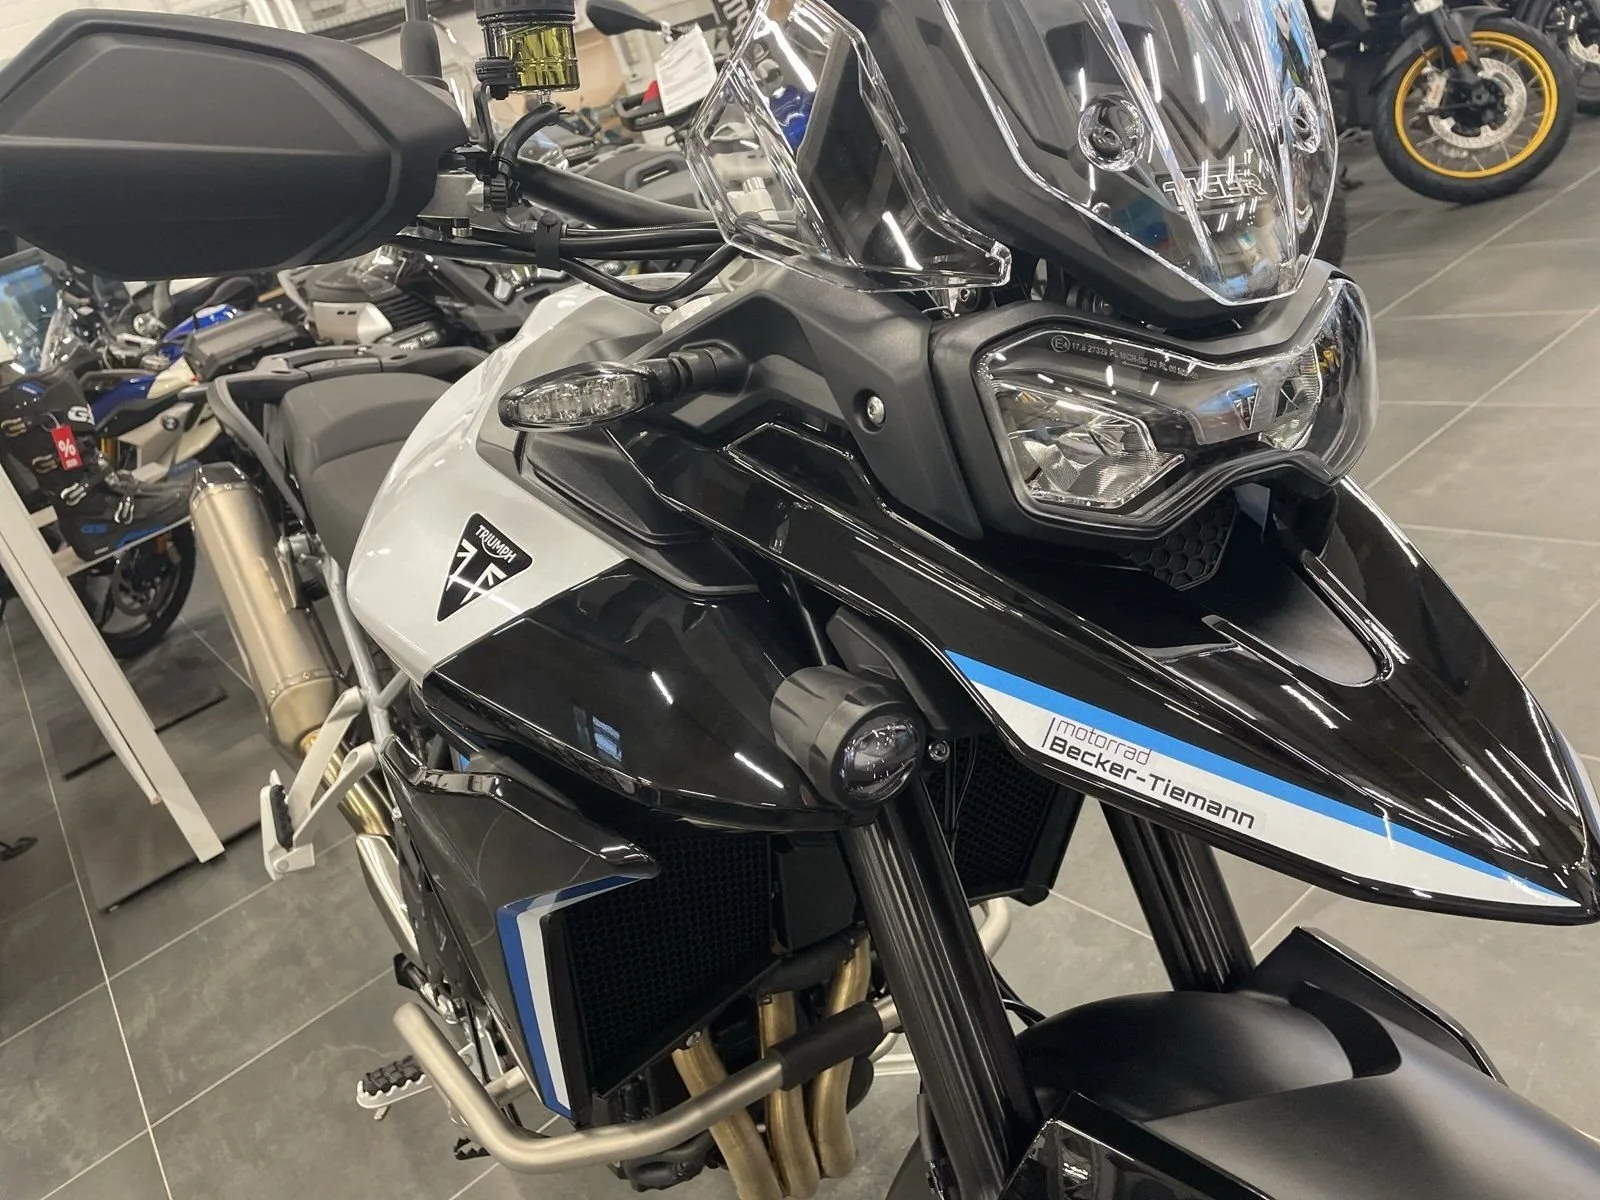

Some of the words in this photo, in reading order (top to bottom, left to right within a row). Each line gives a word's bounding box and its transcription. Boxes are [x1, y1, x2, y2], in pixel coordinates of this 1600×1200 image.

[475, 524, 517, 564] TRIUMPH
[1056, 720, 1152, 766] motorrad
[1049, 735, 1256, 830] Becker-Tiemann
